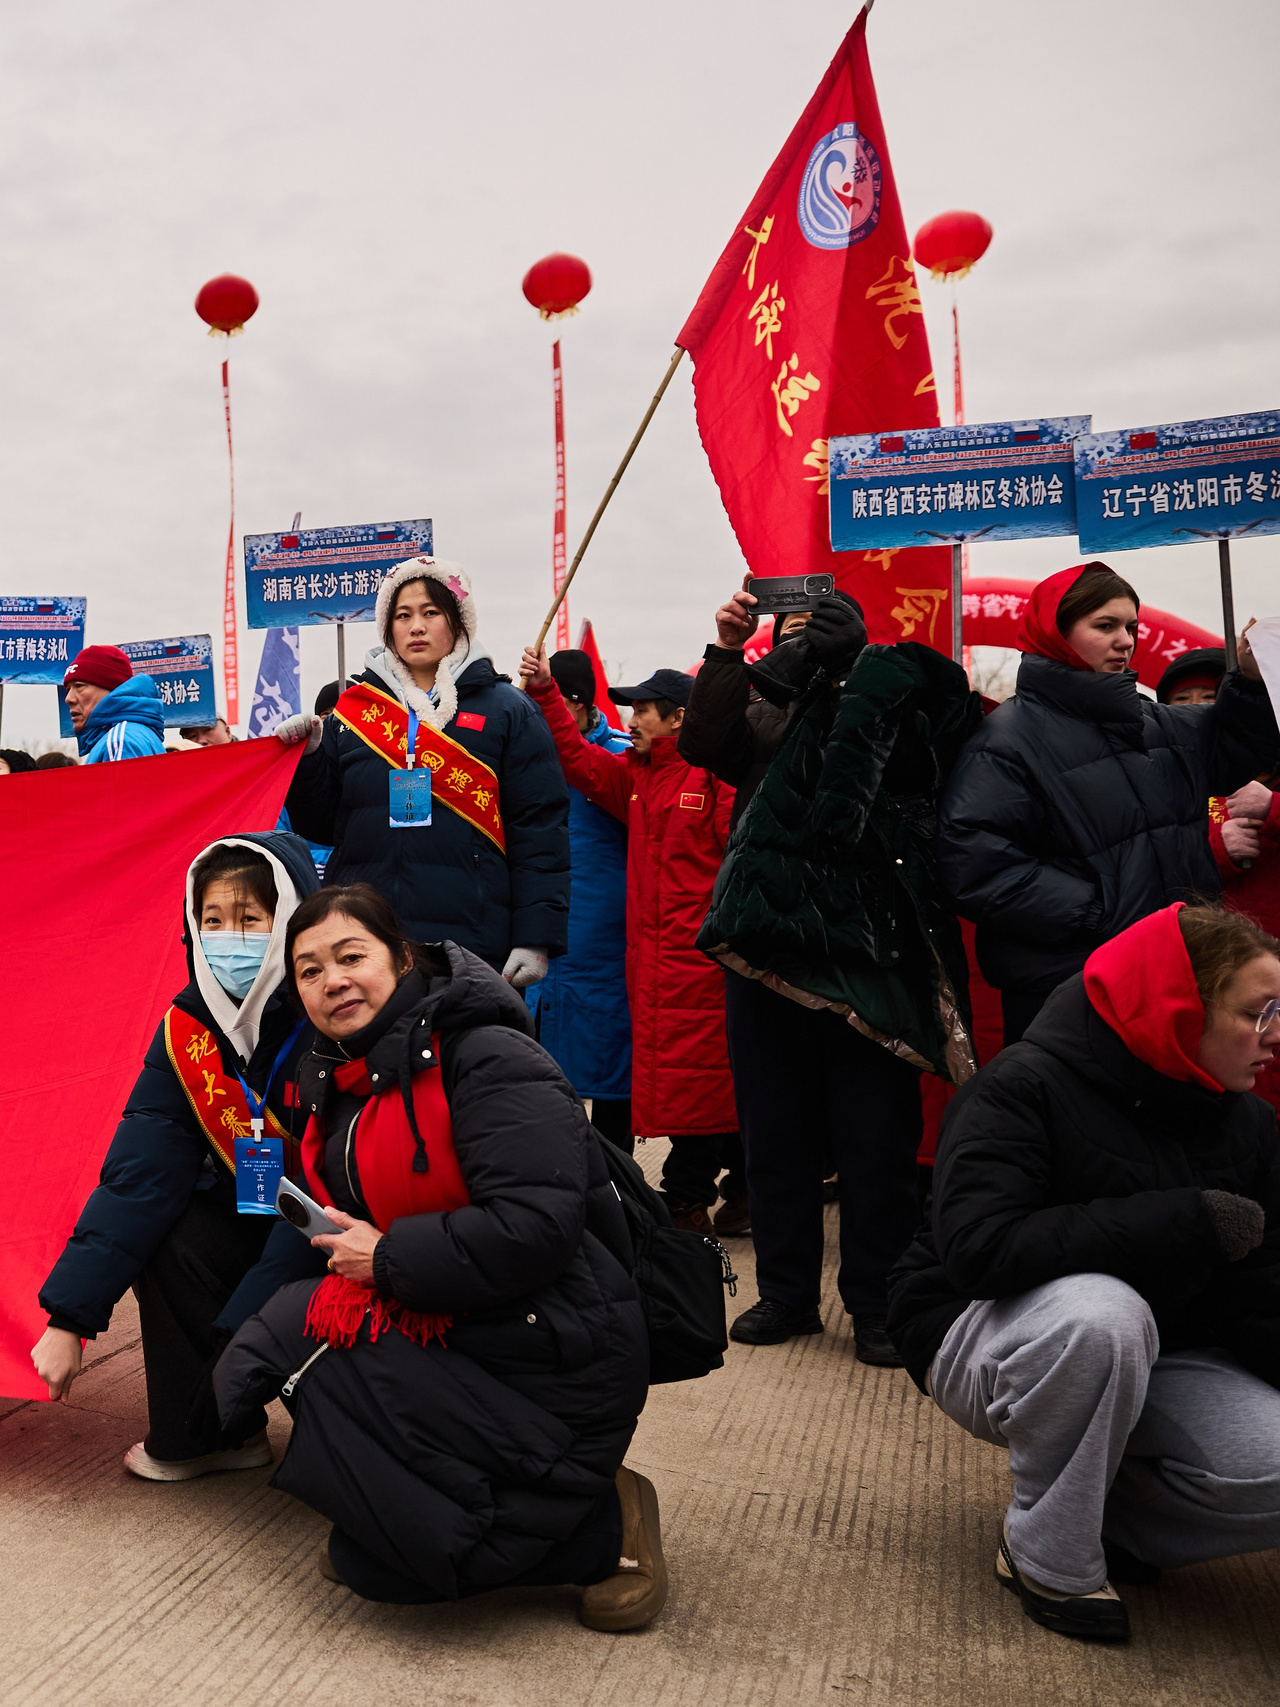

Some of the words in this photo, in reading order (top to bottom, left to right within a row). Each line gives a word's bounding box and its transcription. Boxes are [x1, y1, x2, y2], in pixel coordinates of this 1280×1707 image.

[851, 473, 1064, 520] 陕西省西安市碑林区冬泳协会
[262, 566, 395, 603] 湖南省长沙市游泳
[962, 593, 1029, 621] 跨省汽
[154, 677, 201, 706] 泳协会
[185, 1030, 253, 1141] 祝大赛
[256, 1173, 266, 1203] 工作证
